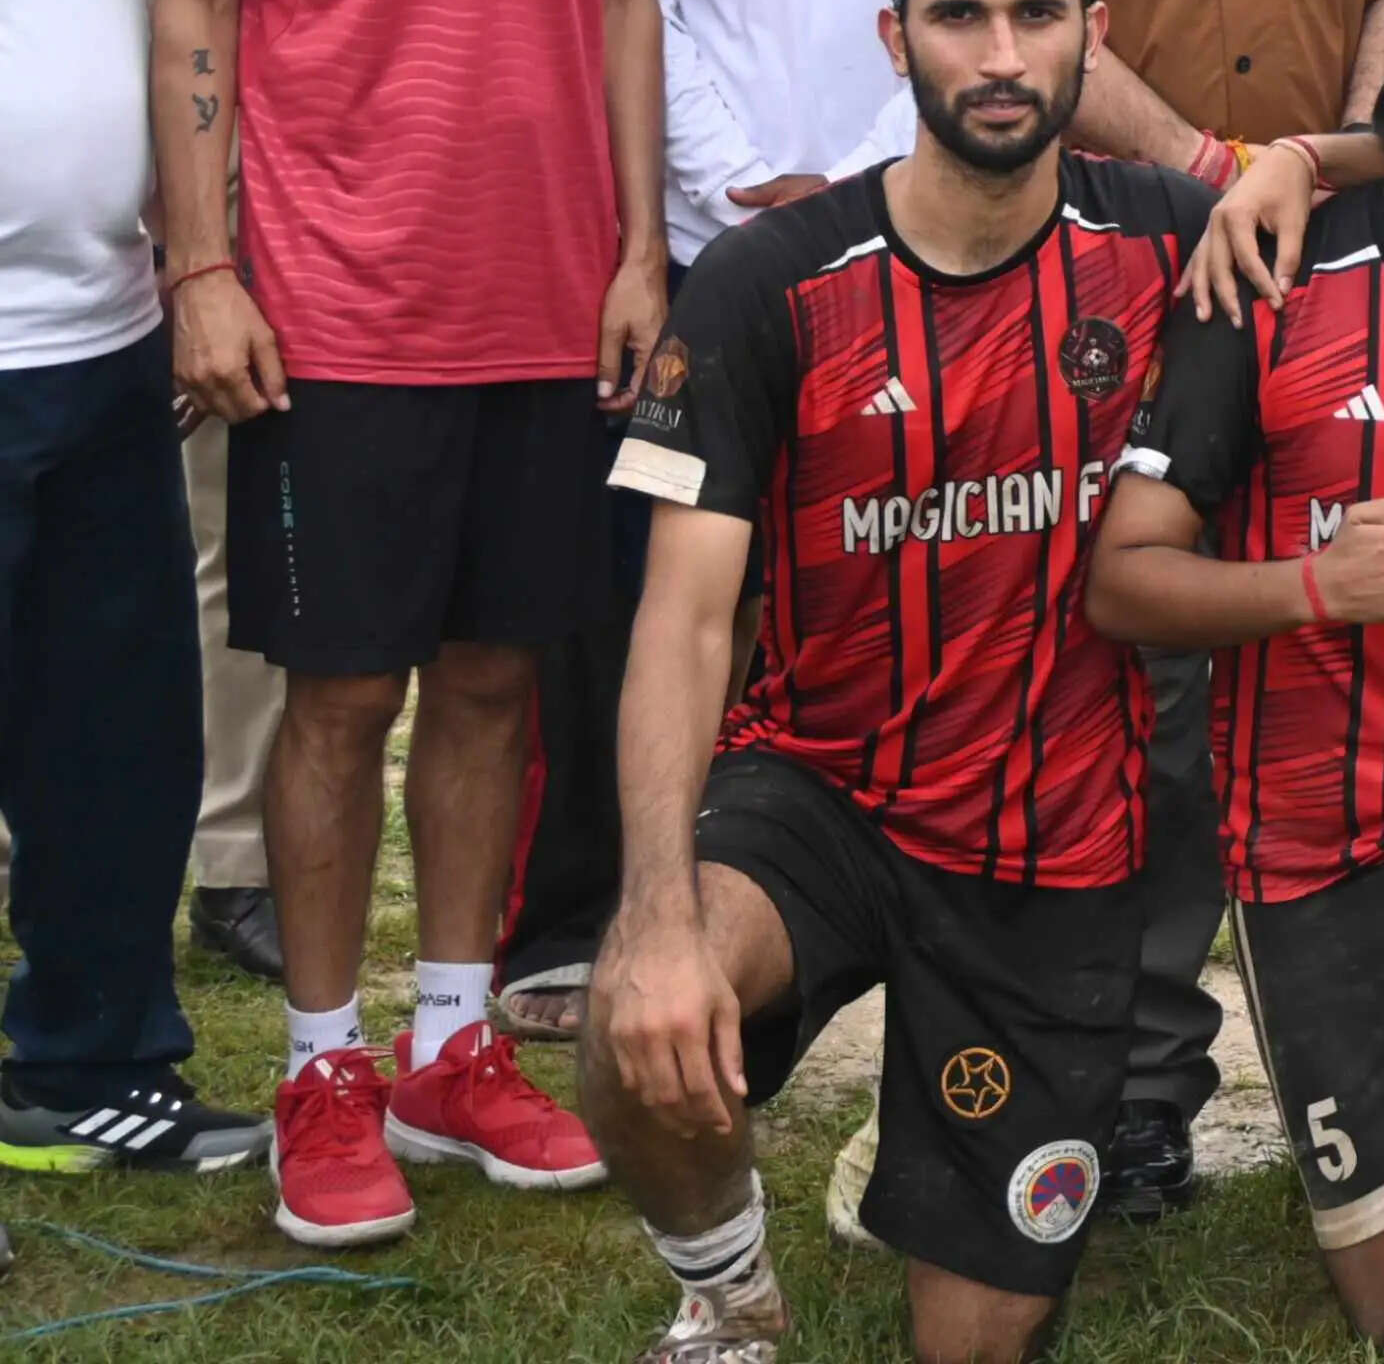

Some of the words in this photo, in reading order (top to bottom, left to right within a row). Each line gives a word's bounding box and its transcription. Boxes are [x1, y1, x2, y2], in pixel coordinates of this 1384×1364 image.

[280, 461, 294, 528] CORE
[842, 467, 1063, 555] MAGICIAN
[1078, 458, 1120, 523] F
[1307, 1096, 1359, 1183] 5
